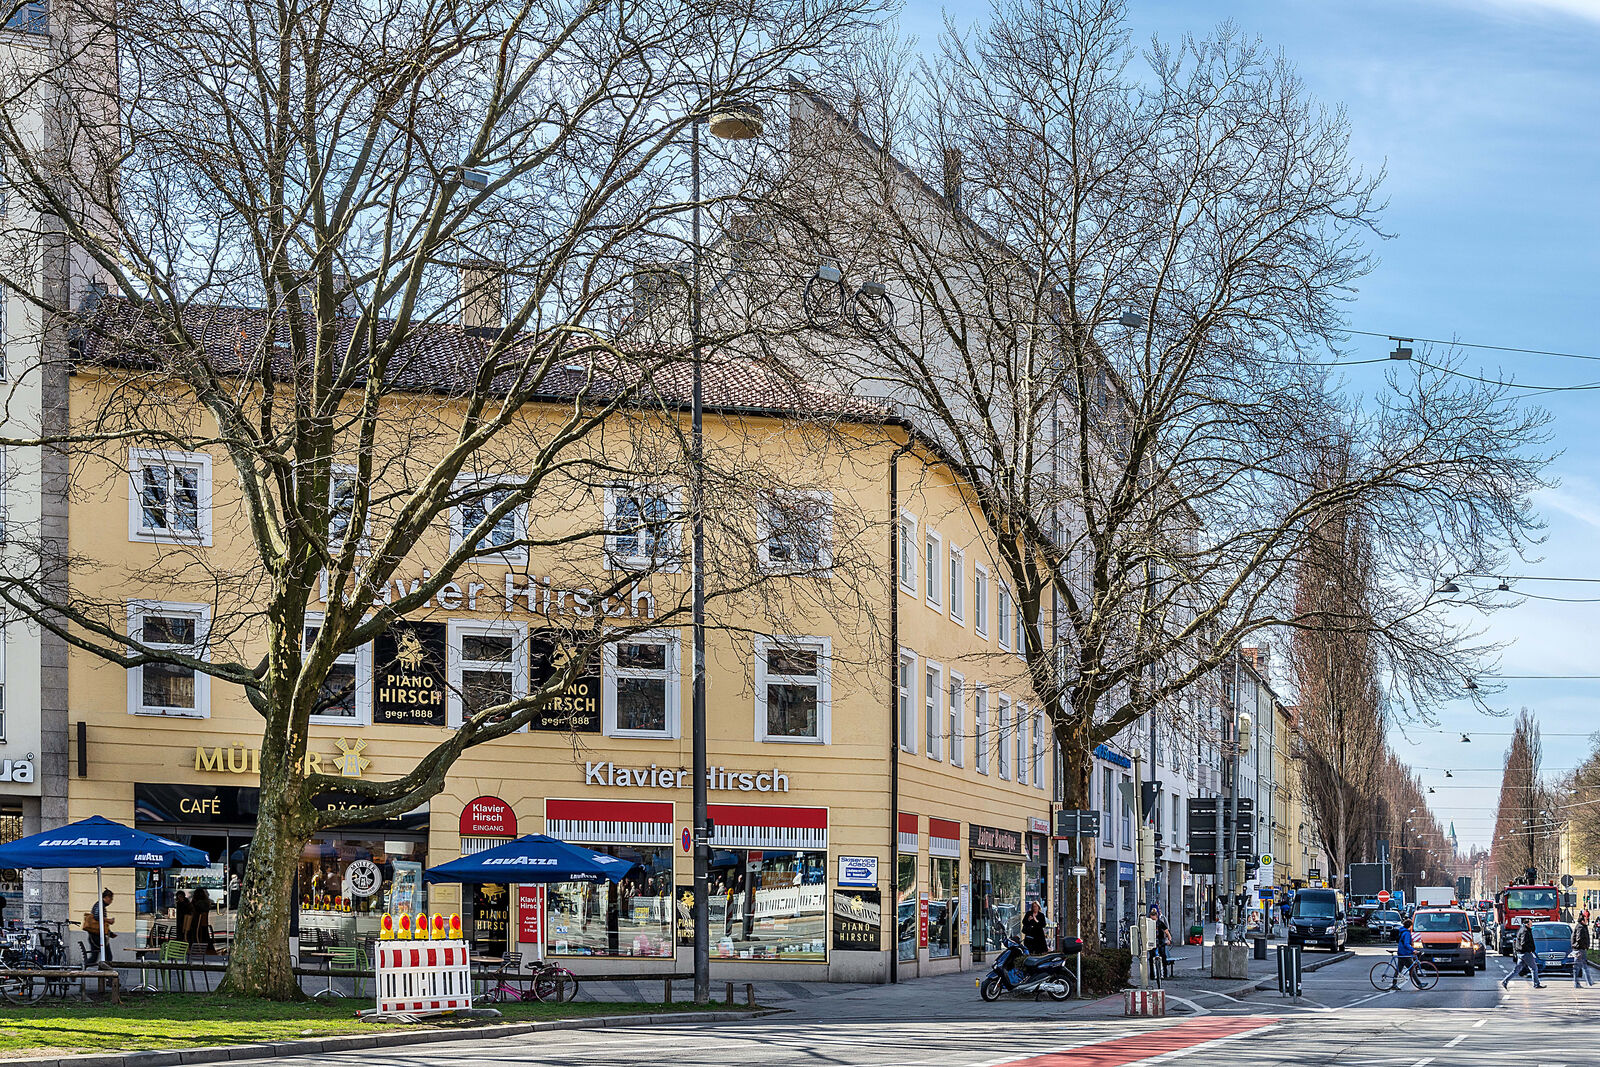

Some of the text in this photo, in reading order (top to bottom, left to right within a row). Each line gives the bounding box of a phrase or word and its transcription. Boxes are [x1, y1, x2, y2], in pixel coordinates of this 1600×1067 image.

[387, 674, 433, 688] PIANO
[379, 687, 441, 705] HIRSCH
[385, 709, 433, 719] gegr. 1888
[569, 716, 590, 726] 888
[194, 740, 325, 777] MÜLR
[585, 761, 688, 789] Klavier
[180, 795, 221, 815] CAFÉ
[472, 803, 505, 813] Klavier
[472, 812, 503, 822] Hirsch
[472, 824, 505, 832] EINGANG
[38, 837, 121, 846] LAVAZZA
[134, 852, 164, 862] LAVAZZA
[482, 856, 558, 865] LAVAZZA
[480, 909, 508, 920] PIANO
[477, 920, 505, 931] HIRSC
[841, 922, 870, 932] PIANO
[839, 932, 875, 942] HIRSCH
